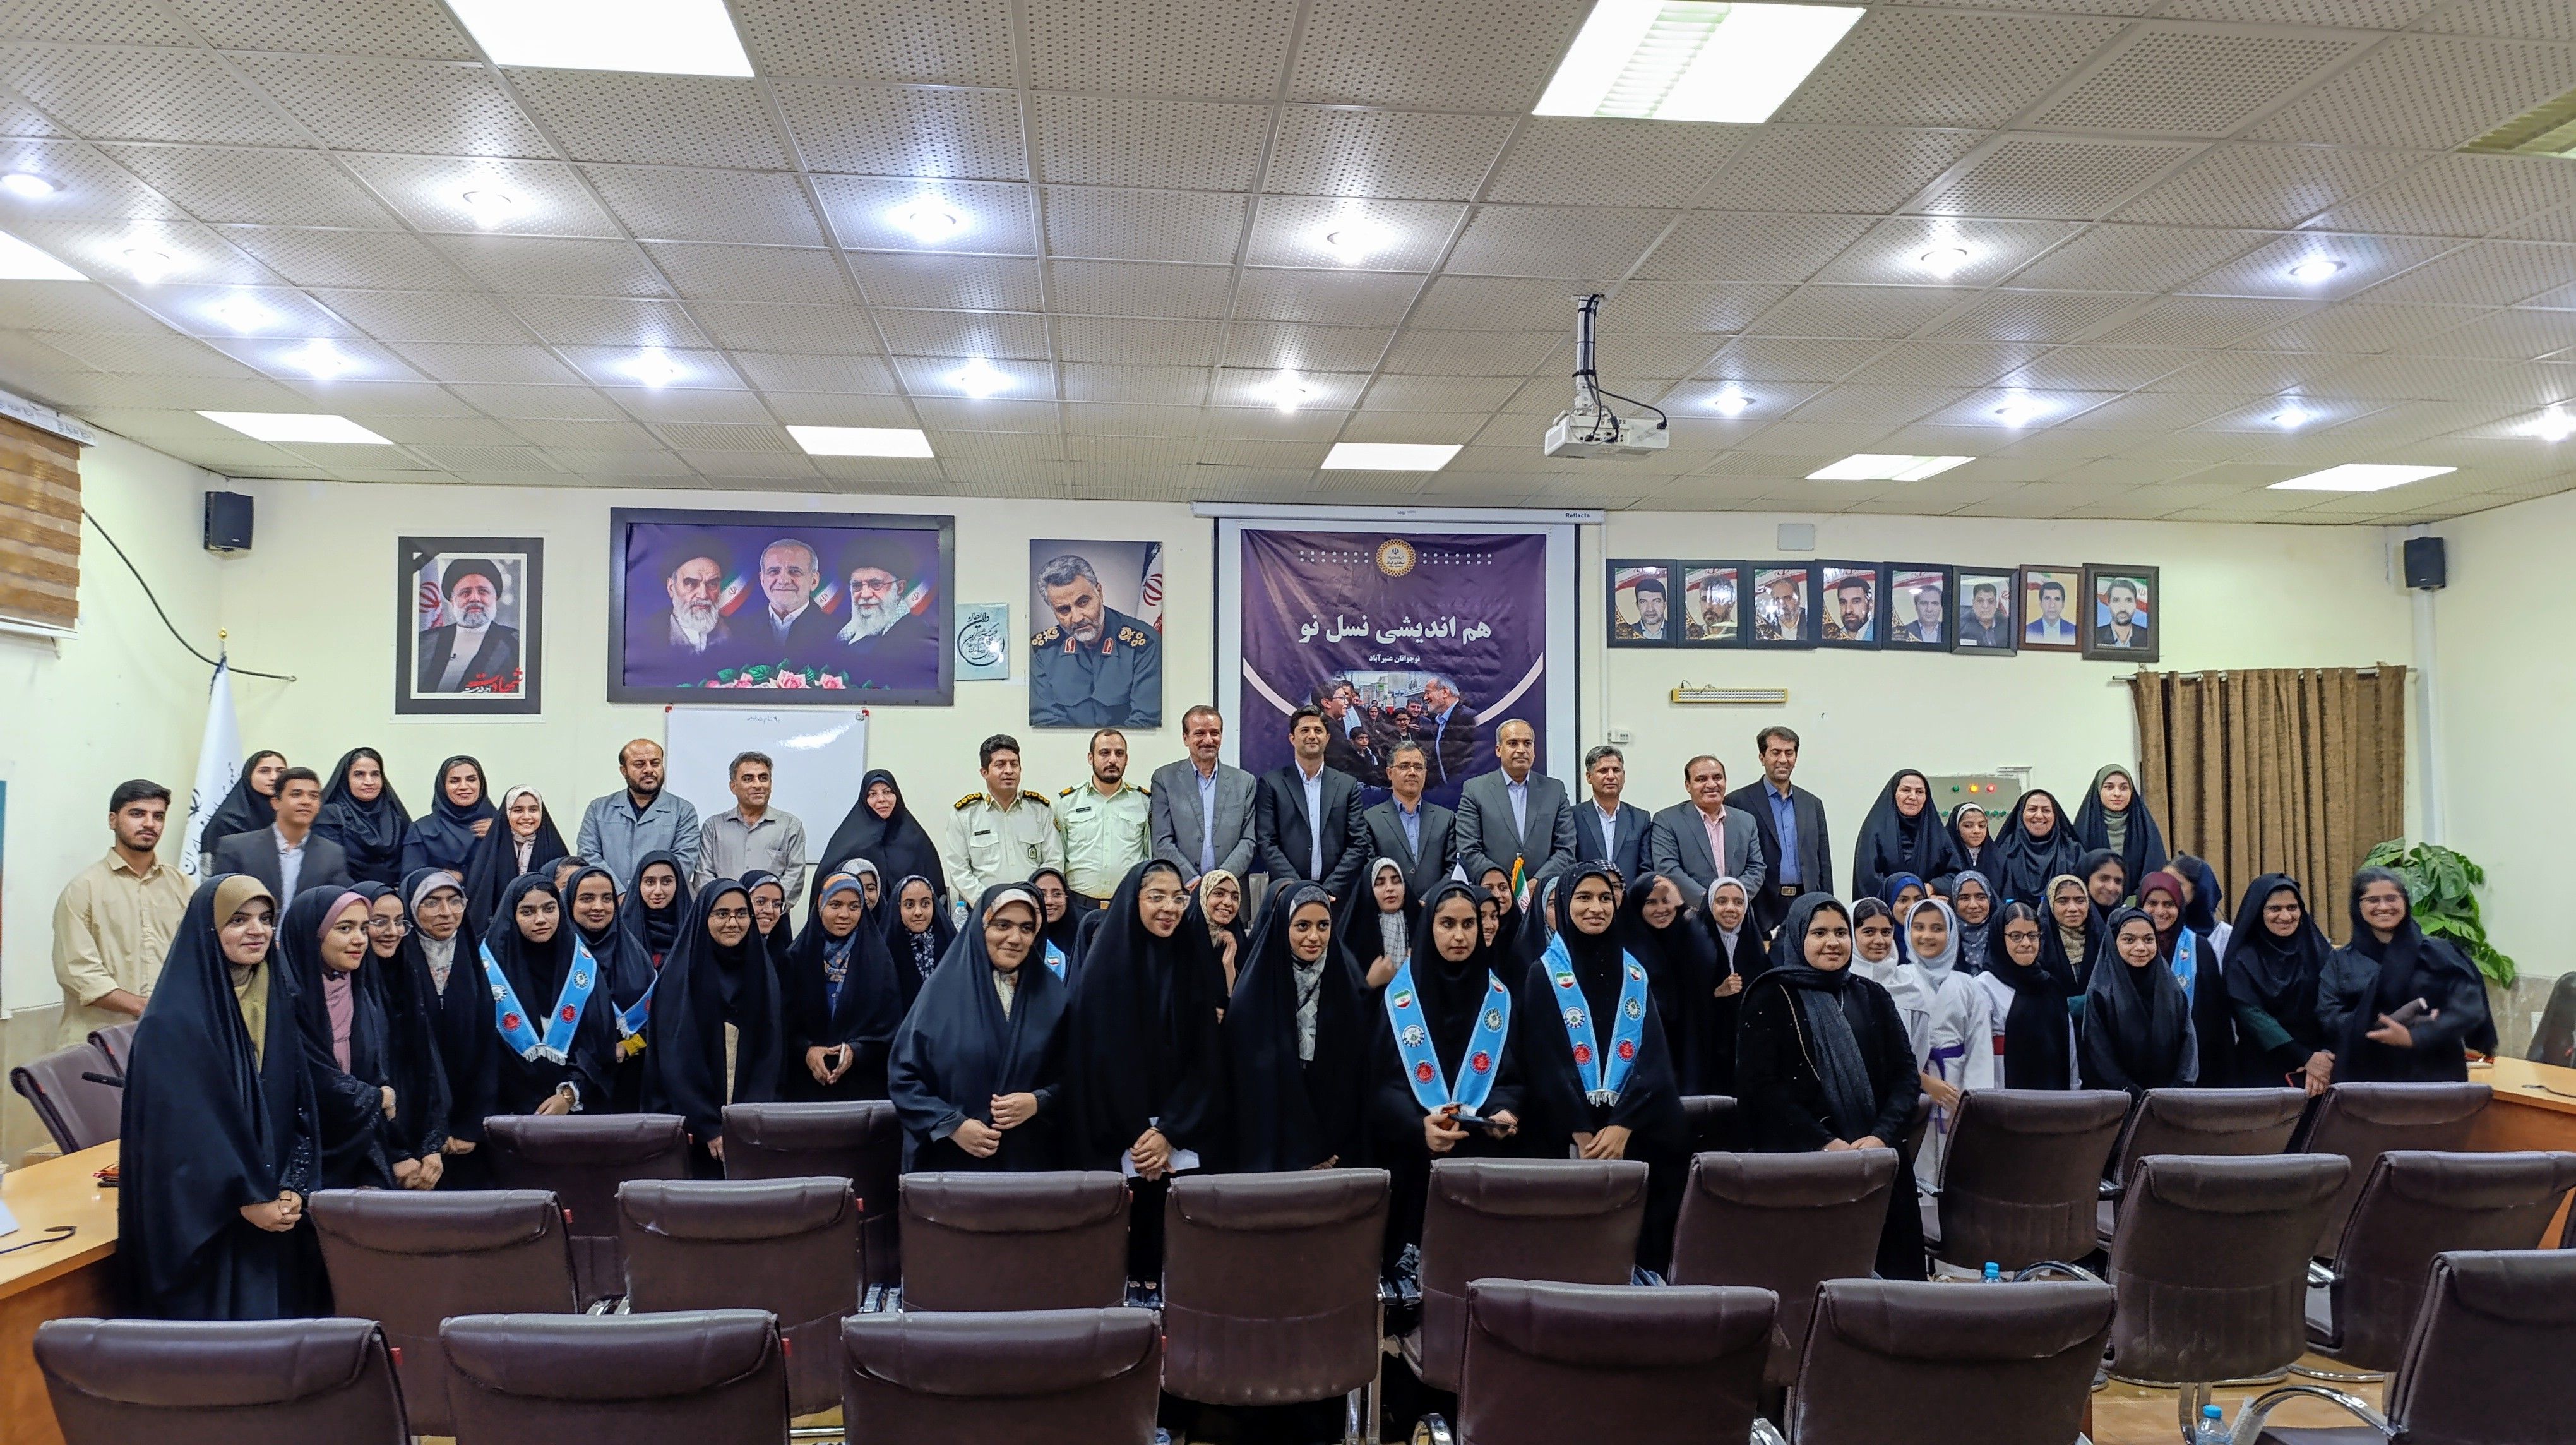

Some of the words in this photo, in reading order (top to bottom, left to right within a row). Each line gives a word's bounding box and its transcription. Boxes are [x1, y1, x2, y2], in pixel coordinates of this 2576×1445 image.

[1298, 614, 1320, 643] نو
[1325, 614, 1369, 643] نسل
[1375, 616, 1456, 644] اندیشی
[1462, 621, 1491, 645] هم
[1393, 654, 1421, 664] نوجوانان
[465, 667, 523, 693] شهادت
